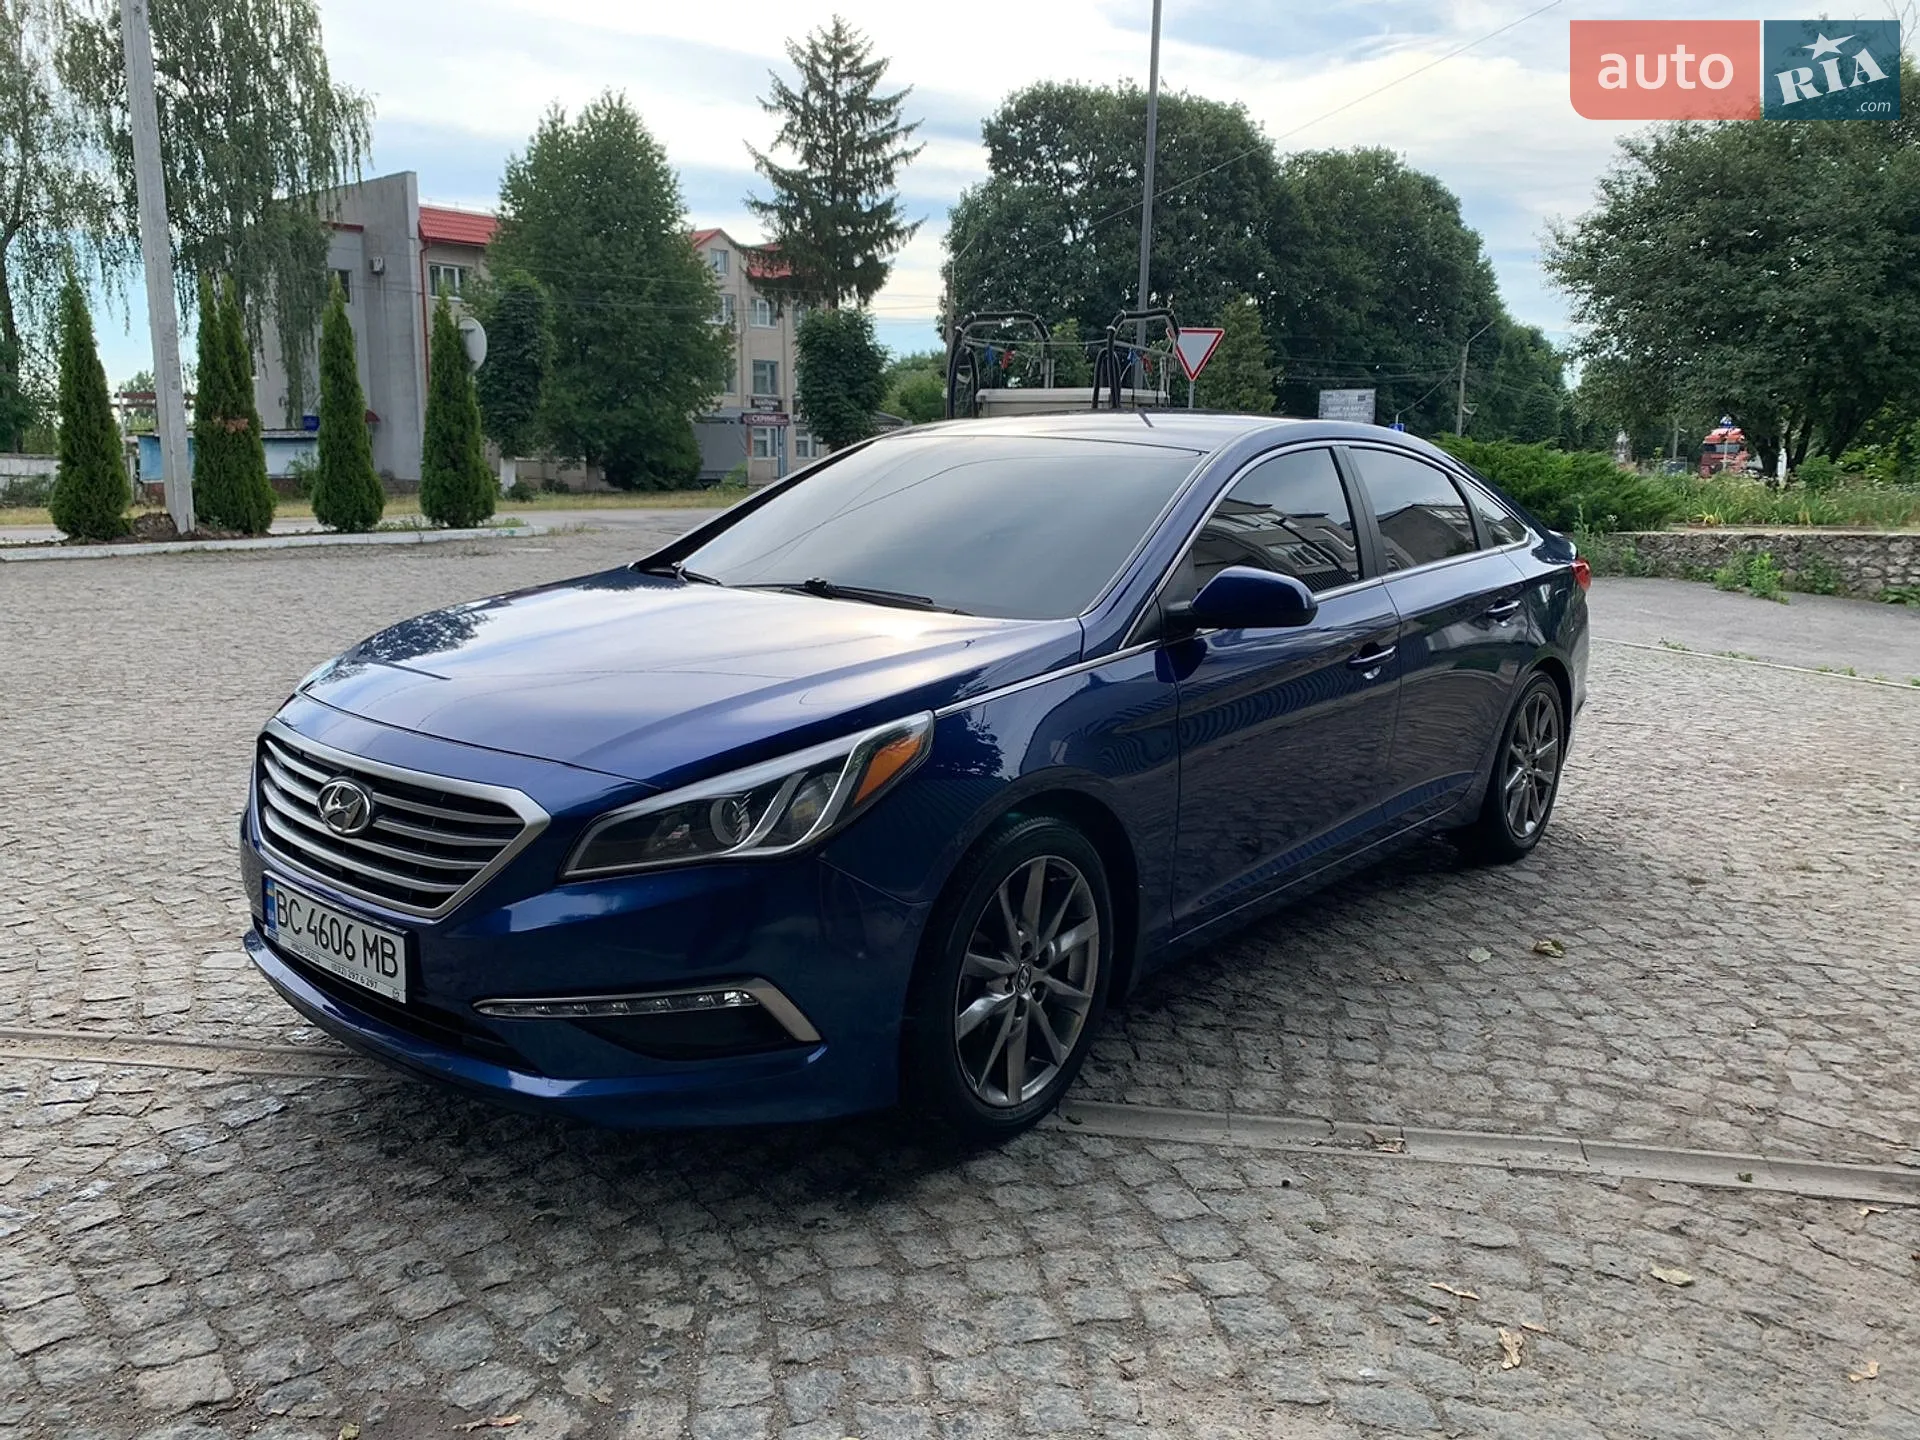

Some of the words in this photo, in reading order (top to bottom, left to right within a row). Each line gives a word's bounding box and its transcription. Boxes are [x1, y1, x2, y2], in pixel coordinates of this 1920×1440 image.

[277, 890, 302, 935] BC
[307, 908, 356, 961] 4606
[362, 929, 398, 978] MB
